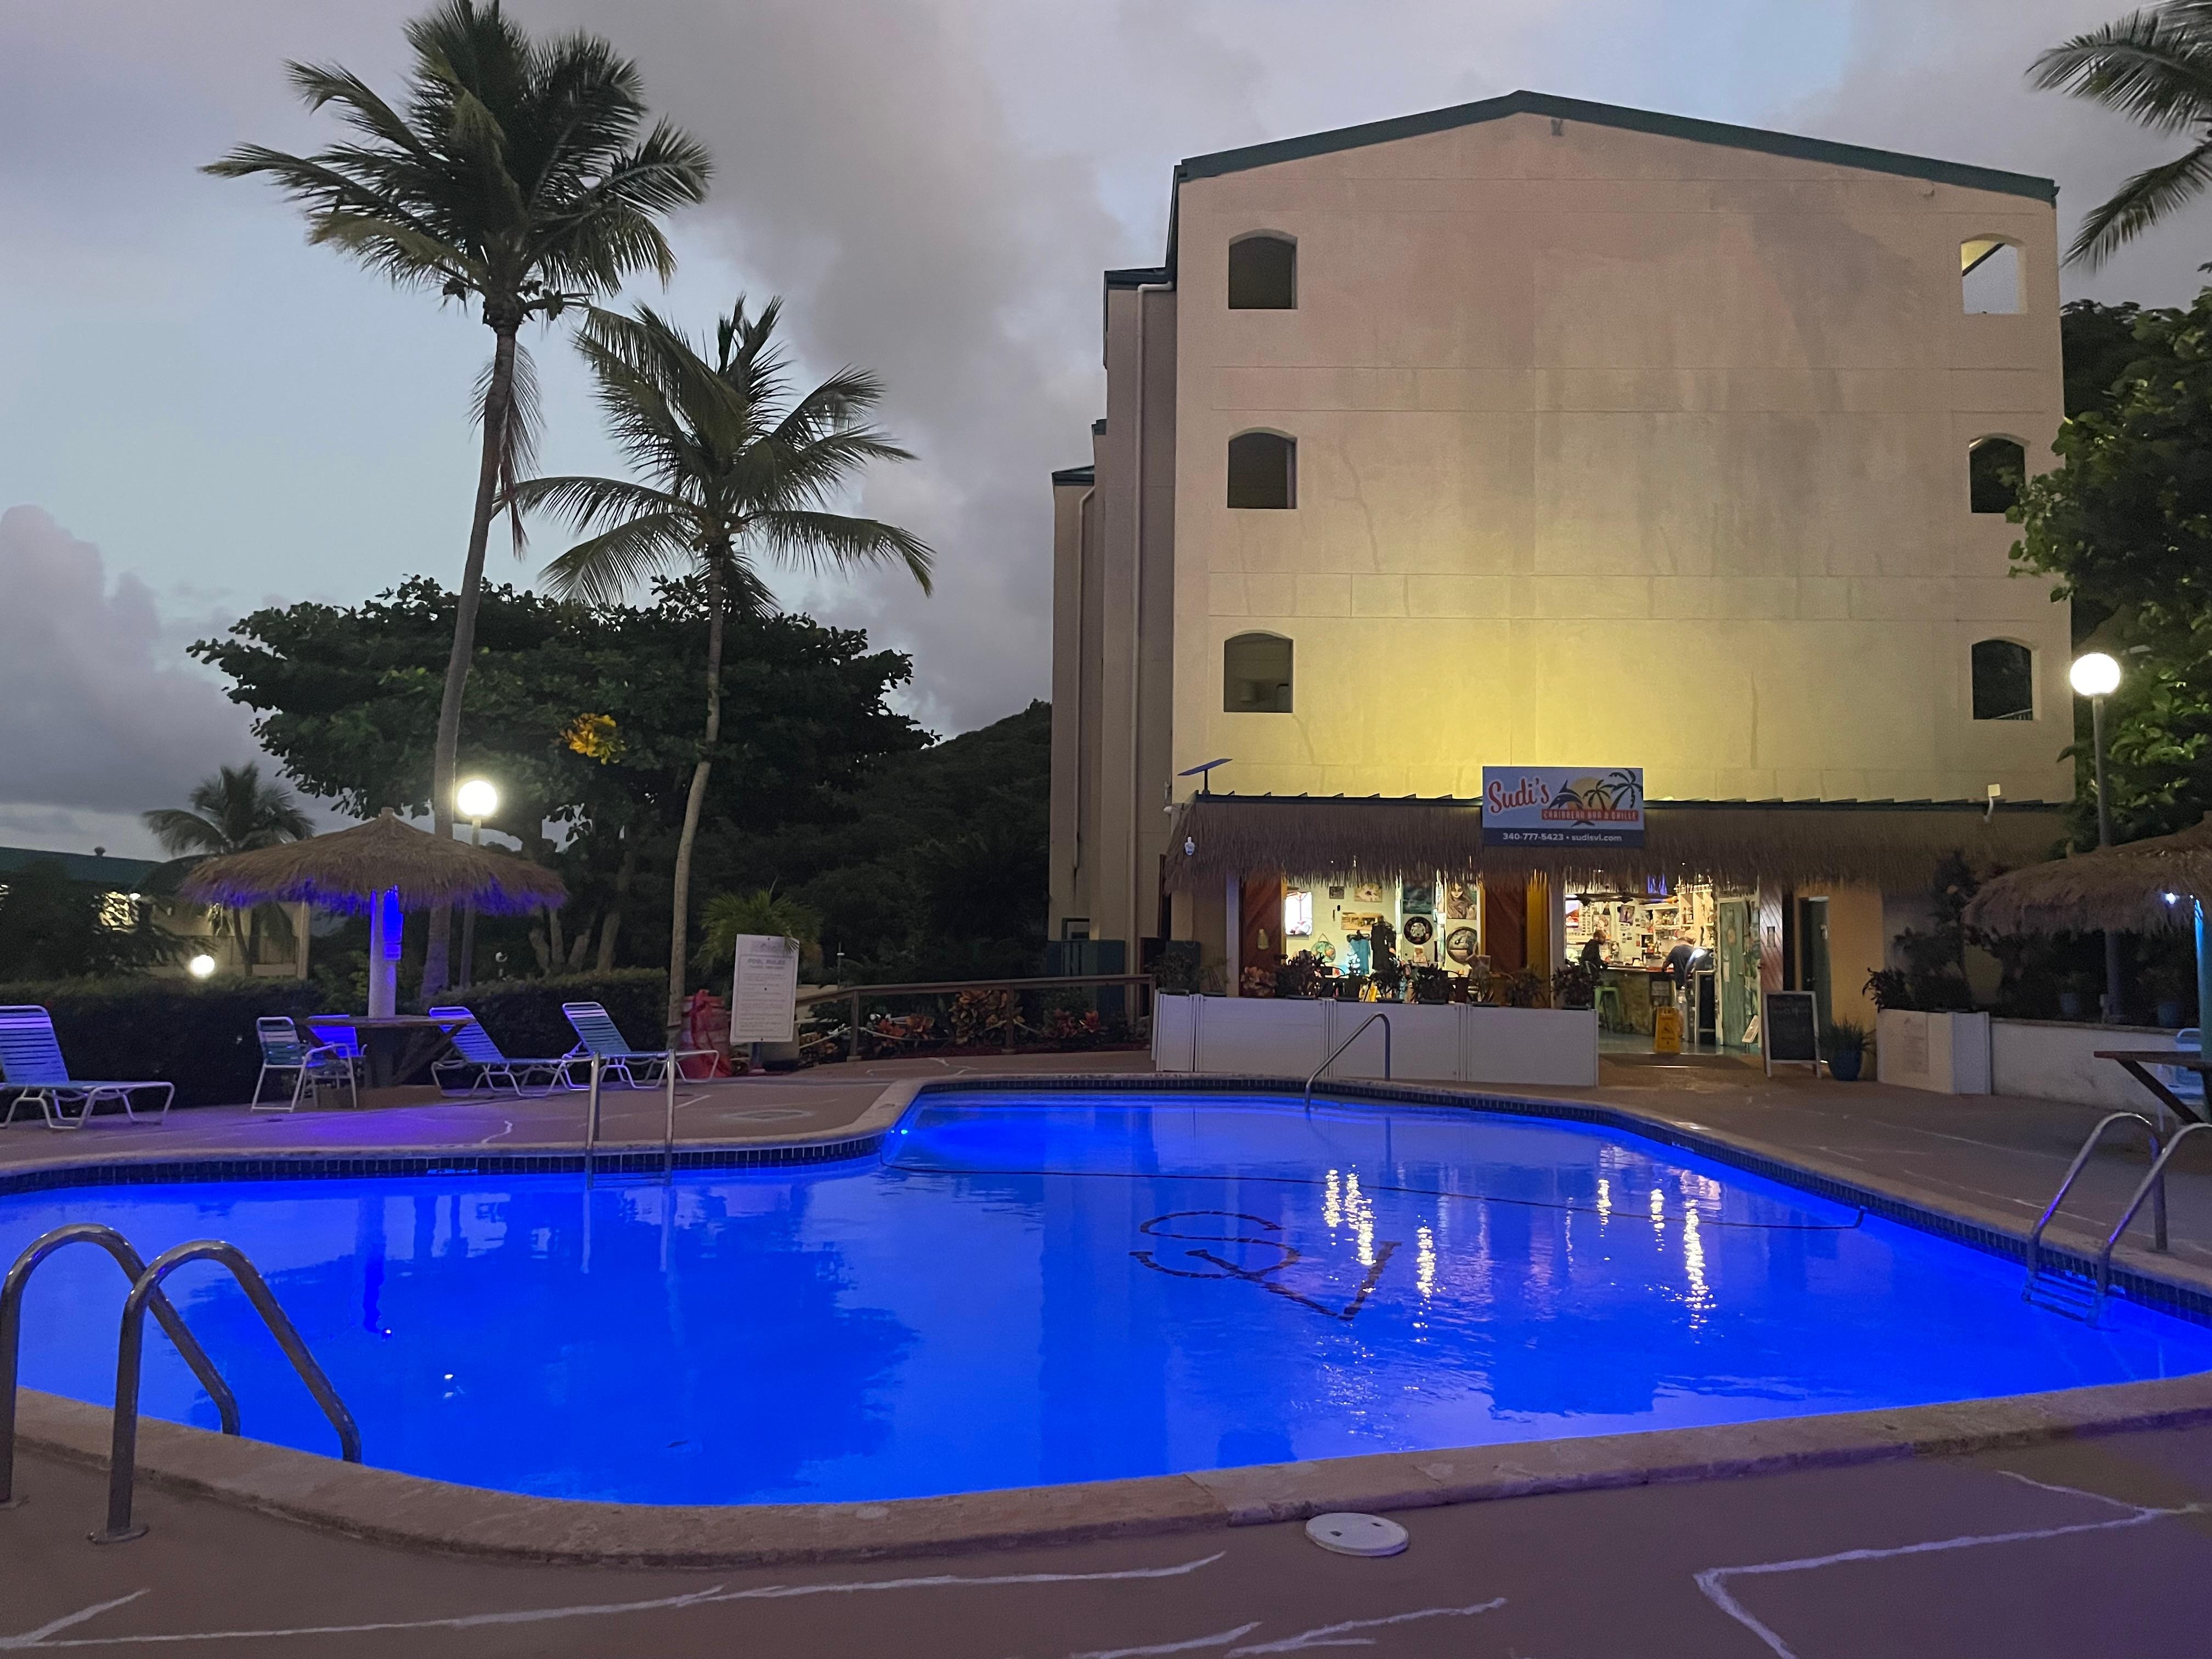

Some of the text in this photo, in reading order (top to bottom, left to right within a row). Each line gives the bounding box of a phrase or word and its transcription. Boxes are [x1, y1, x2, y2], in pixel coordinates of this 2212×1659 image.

[1488, 777, 1549, 814] Sudi's
[1503, 832, 1622, 842] 340-777-5423 sudisvi.com
